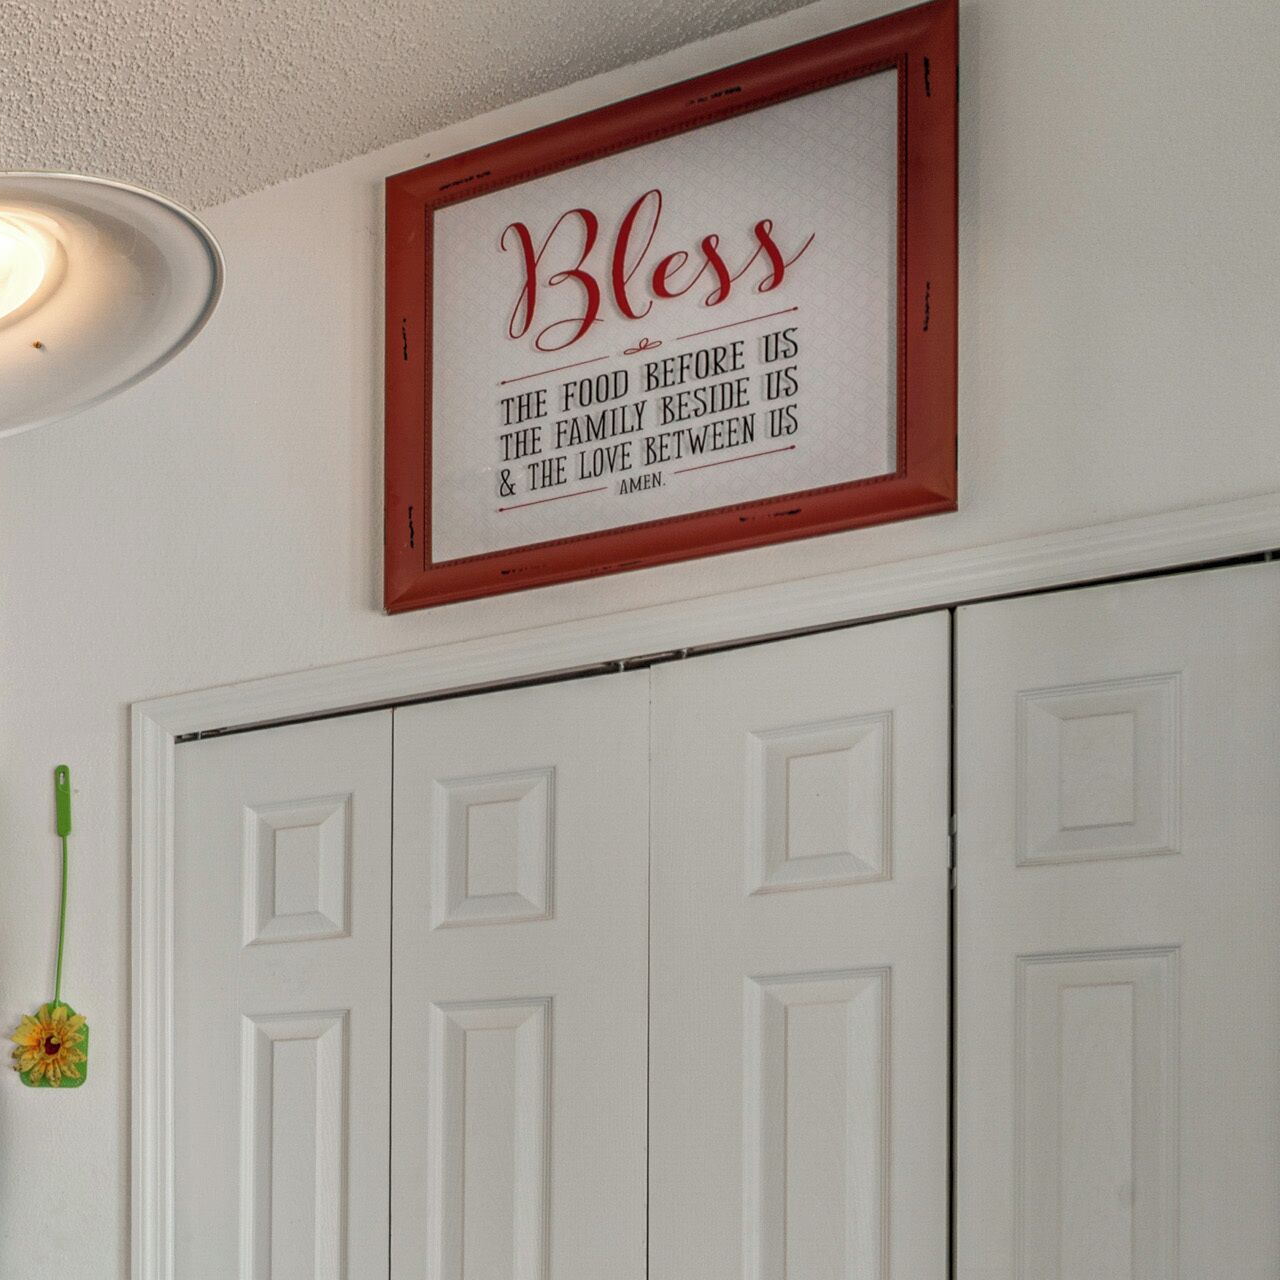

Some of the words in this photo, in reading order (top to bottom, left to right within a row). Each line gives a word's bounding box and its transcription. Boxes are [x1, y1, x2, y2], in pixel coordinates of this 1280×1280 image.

[500, 188, 815, 352] Bless
[500, 390, 548, 426] THE
[562, 369, 629, 411] FOOD
[645, 341, 746, 393] BEFORE
[762, 328, 799, 363] US
[500, 426, 542, 463] THE
[554, 401, 646, 449] FAMILY
[661, 376, 750, 425] BESIDE
[765, 366, 799, 400] US
[499, 468, 516, 497] &
[528, 456, 567, 491] THE
[579, 441, 632, 481] LOVE
[644, 413, 756, 465] BETWEEN
[769, 404, 799, 438] US
[618, 472, 666, 496] AMEN.
